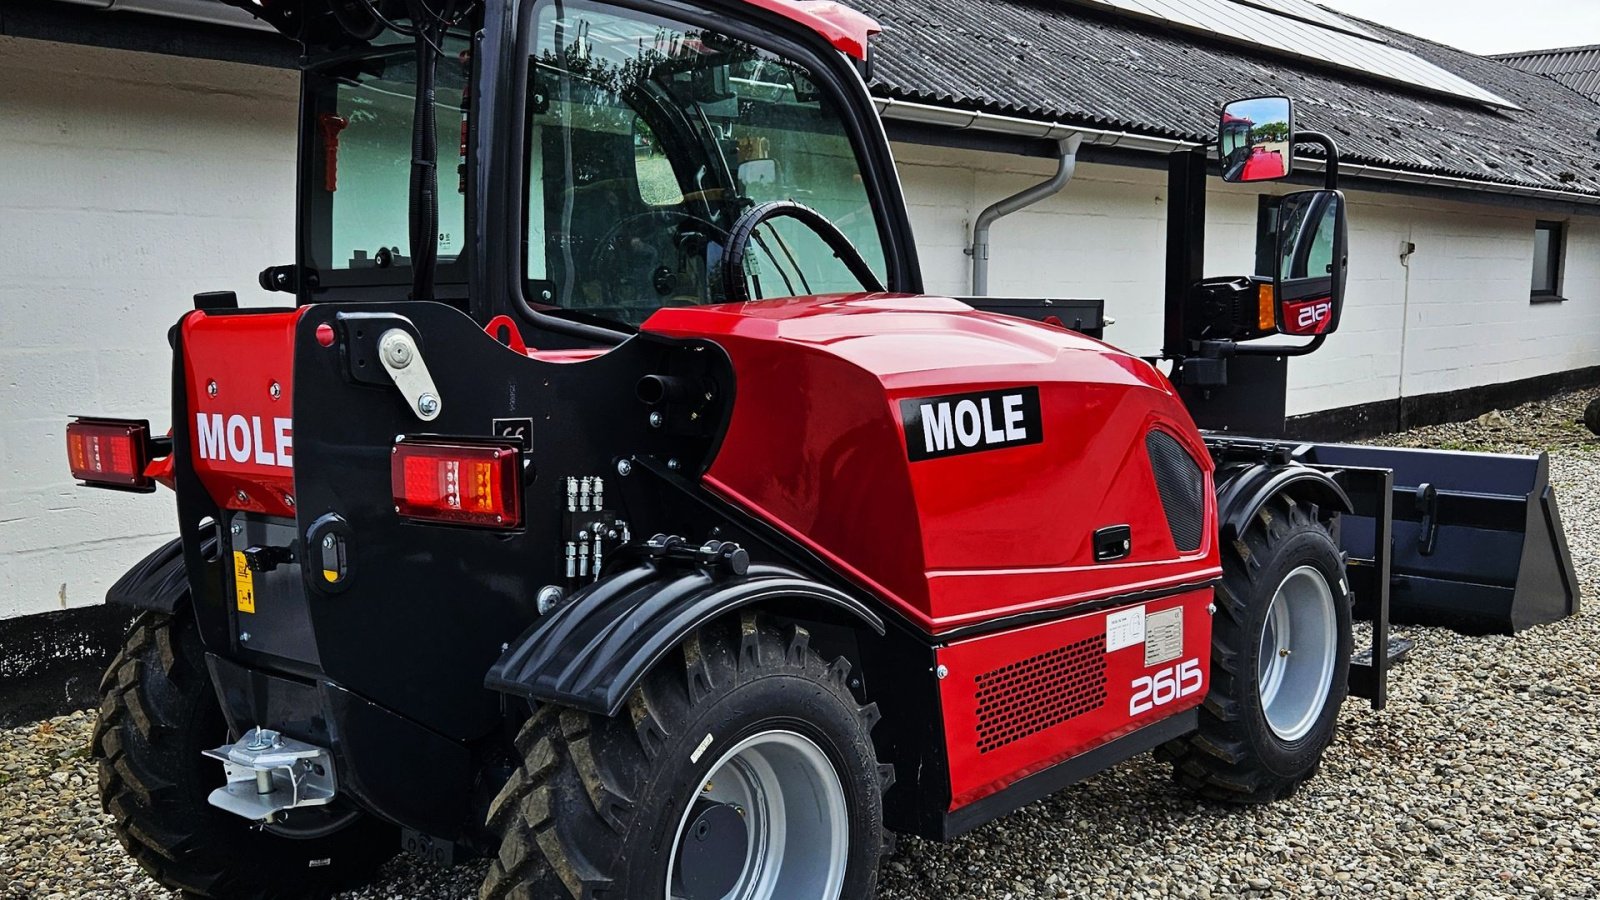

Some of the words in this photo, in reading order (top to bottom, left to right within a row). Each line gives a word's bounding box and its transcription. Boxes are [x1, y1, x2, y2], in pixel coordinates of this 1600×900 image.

[196, 412, 293, 468] MOLE
[920, 394, 1027, 453] MOLE
[1129, 657, 1203, 717] 2615
